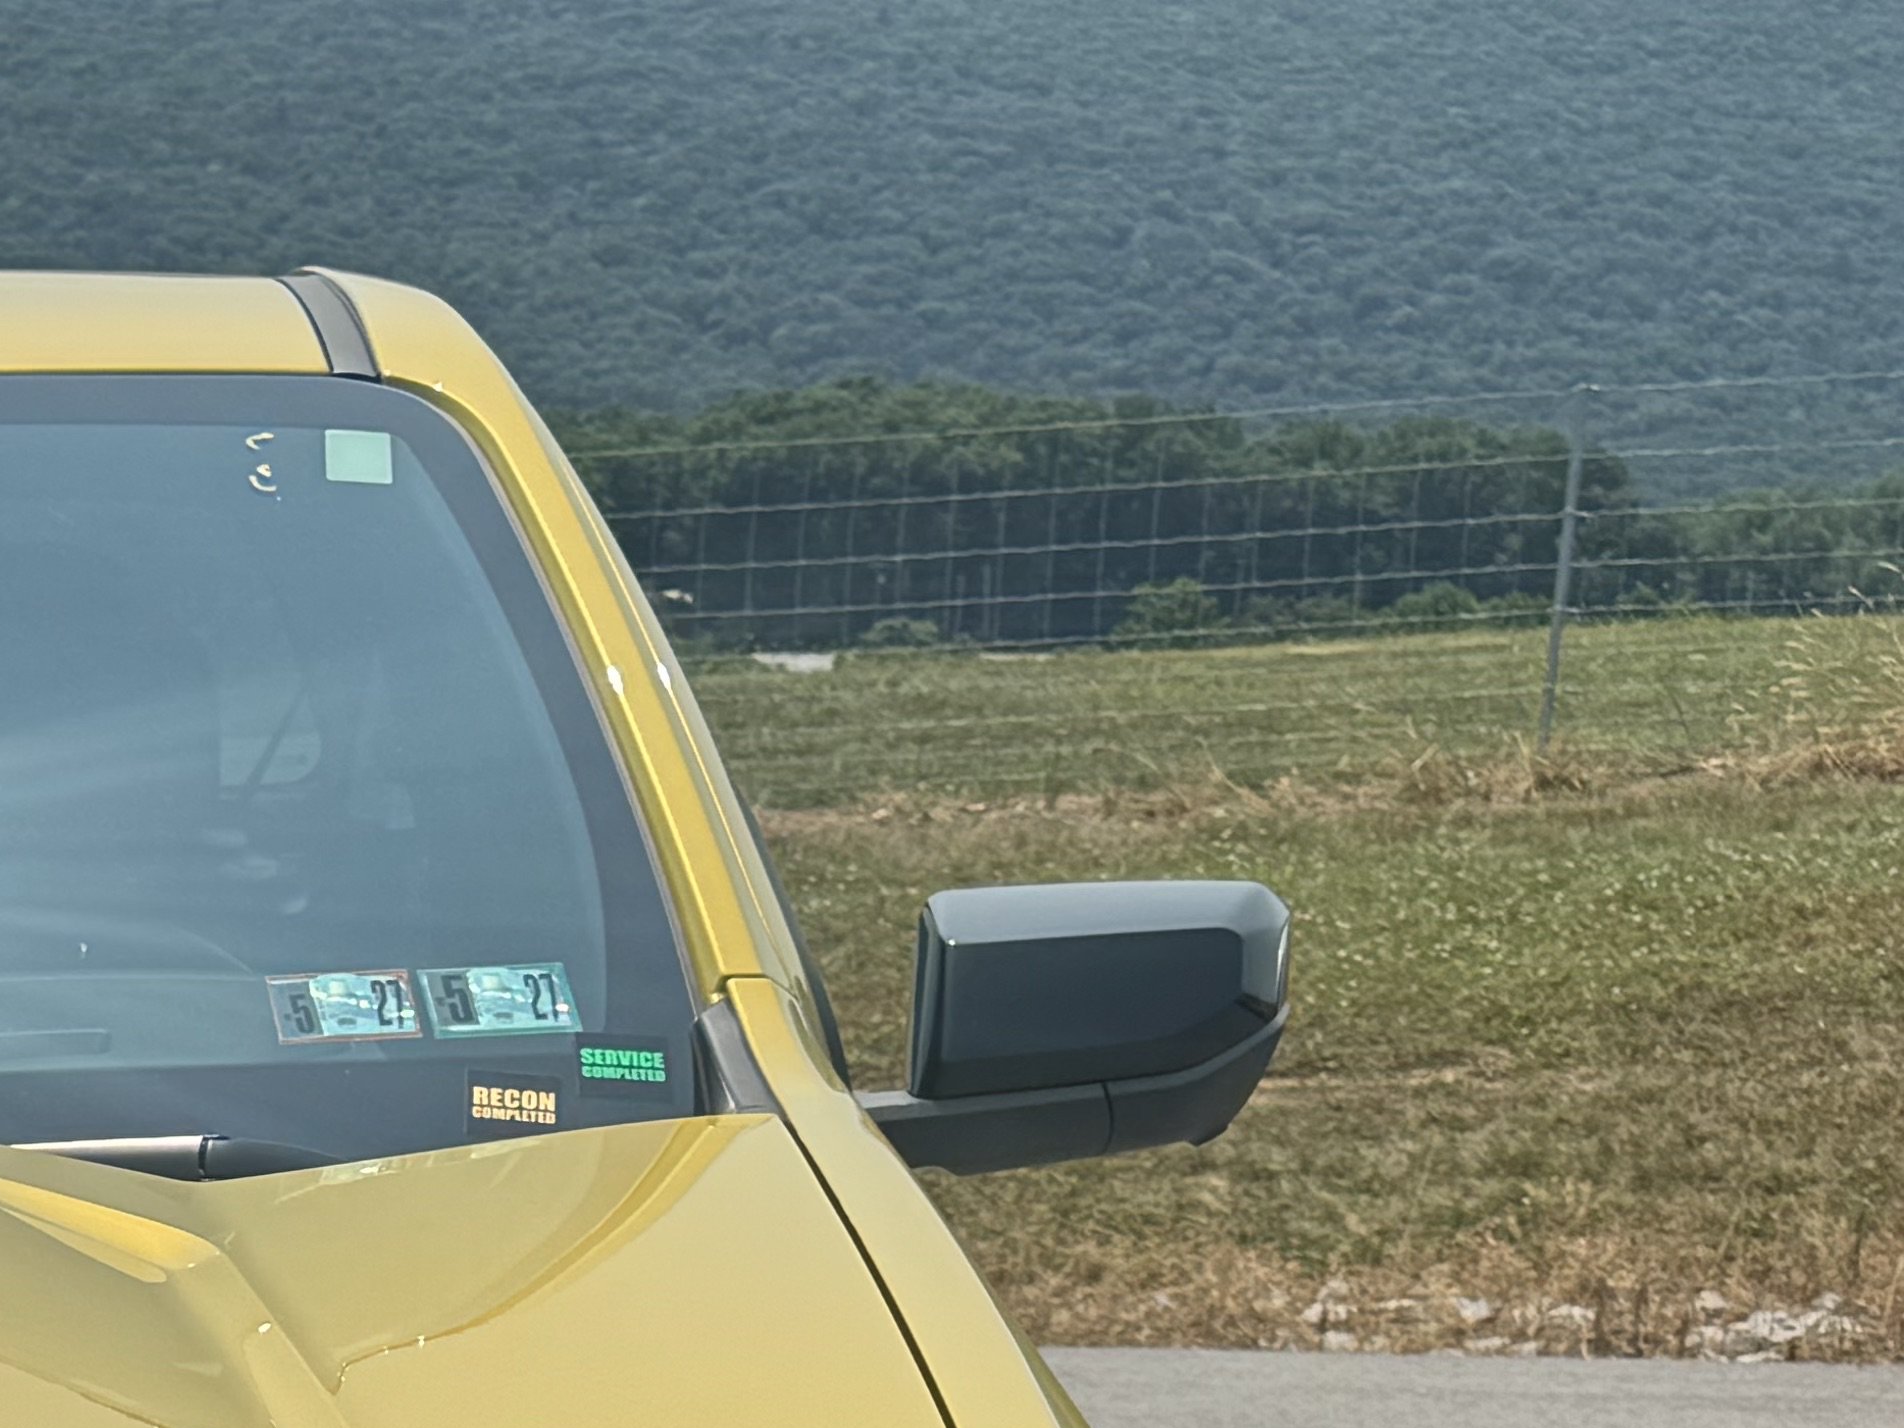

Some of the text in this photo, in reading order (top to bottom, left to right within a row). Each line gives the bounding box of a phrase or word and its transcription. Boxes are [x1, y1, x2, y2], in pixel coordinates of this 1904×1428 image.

[370, 979, 405, 1029] 27
[522, 973, 560, 1023] 27
[579, 1047, 665, 1069] SERVICE
[581, 1065, 667, 1083] COMPLETED
[472, 1085, 556, 1112] RECON
[471, 1105, 557, 1125] COMPLETED
